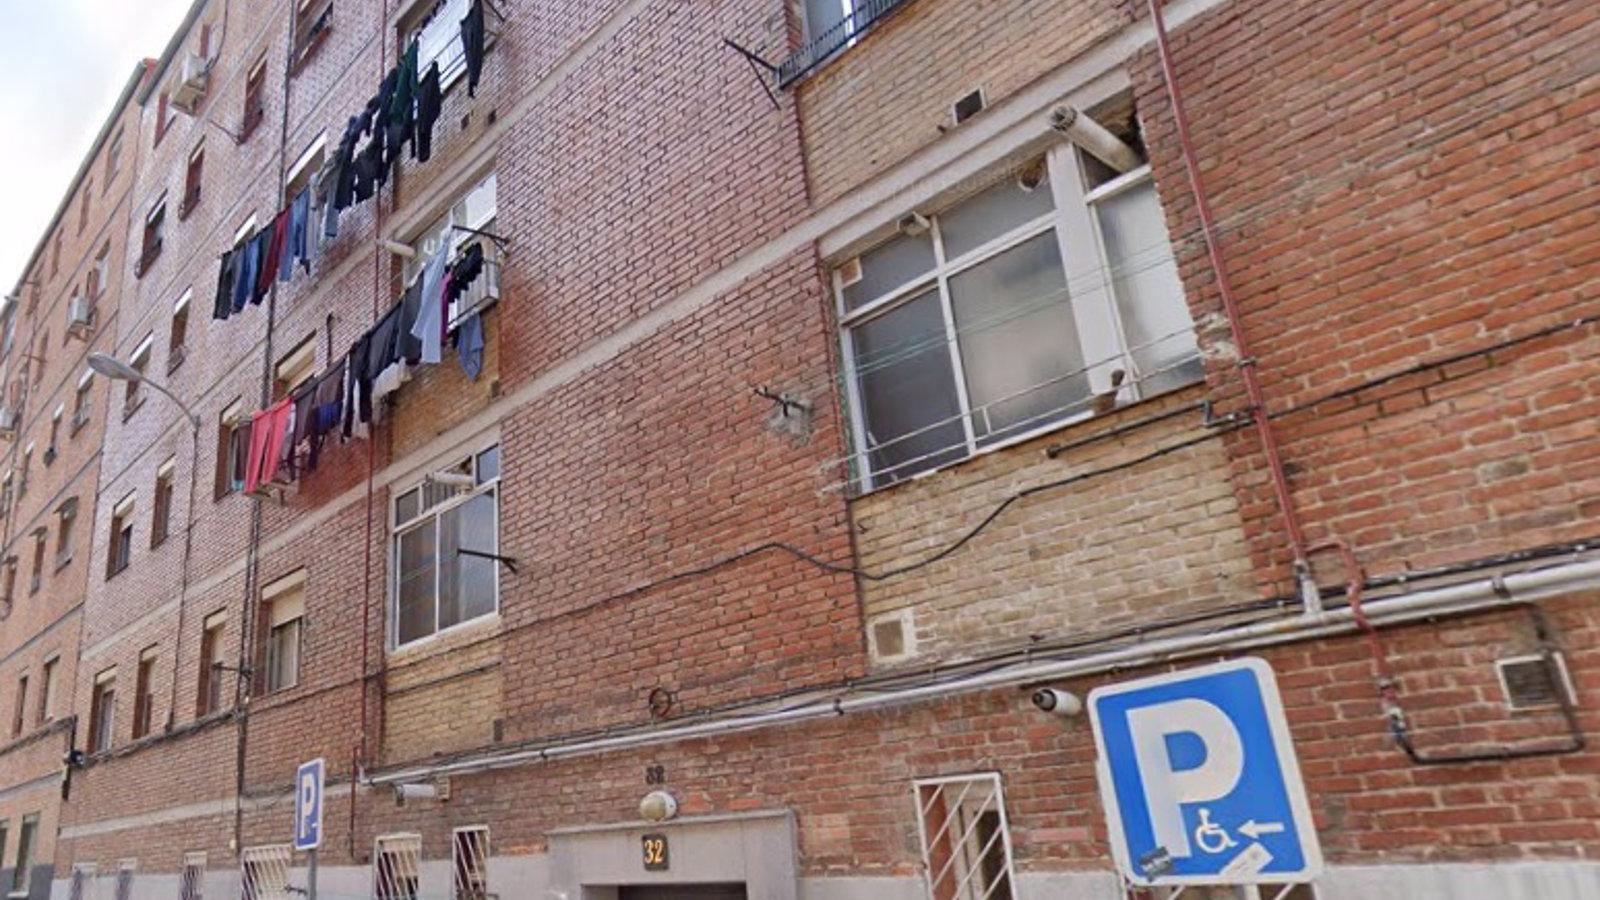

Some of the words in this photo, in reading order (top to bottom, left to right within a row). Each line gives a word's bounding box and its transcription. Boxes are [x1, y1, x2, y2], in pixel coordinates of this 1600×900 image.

[300, 773, 315, 839] P
[1126, 697, 1244, 858] P
[644, 839, 665, 864] 32
